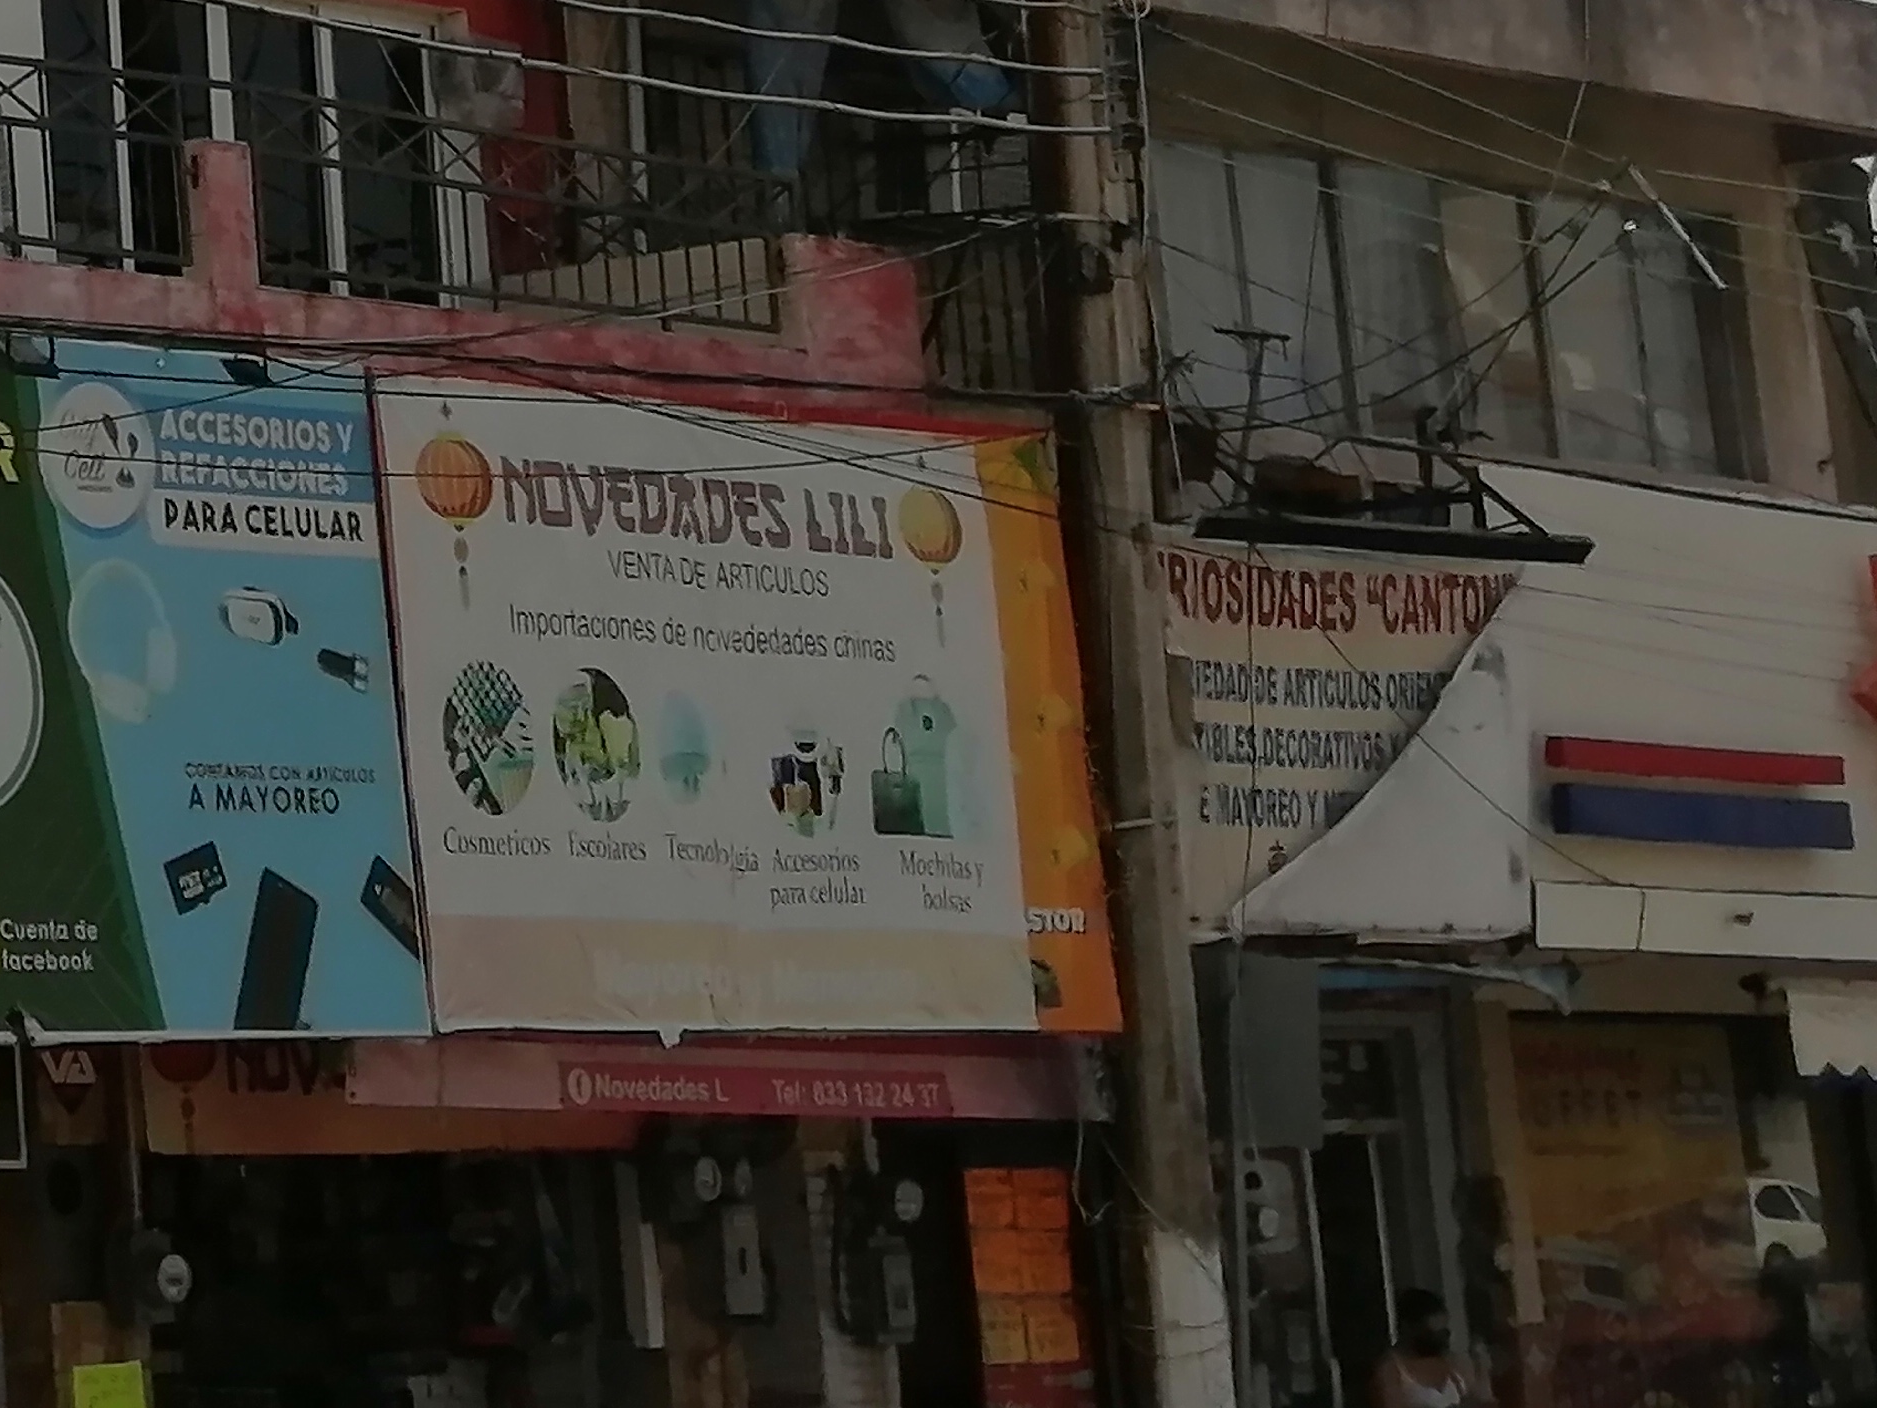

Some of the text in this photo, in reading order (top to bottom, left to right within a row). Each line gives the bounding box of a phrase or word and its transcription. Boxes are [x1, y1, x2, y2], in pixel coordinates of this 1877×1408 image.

[159, 407, 354, 456] ACCESORIOS Y
[160, 448, 349, 497] REFACCIONES
[164, 497, 363, 541] PARA CELULAR
[500, 455, 894, 560] NOVEDADES LILI
[607, 549, 829, 597] VENTA DE ARTICULOS
[1167, 551, 1357, 633] RIOSIDADES
[508, 603, 657, 642] Importaciones
[662, 616, 686, 647] de
[833, 629, 896, 663] chinas
[188, 783, 340, 814] A MAYOREO
[443, 825, 552, 857] Cosmeticos
[568, 829, 647, 861] Escolares
[772, 846, 861, 873] Accesorios
[770, 877, 867, 910] para celular
[74, 920, 100, 942] de
[1, 948, 95, 972] facebook
[594, 1073, 711, 1103] Novedades
[771, 1078, 805, 1105] Tel:
